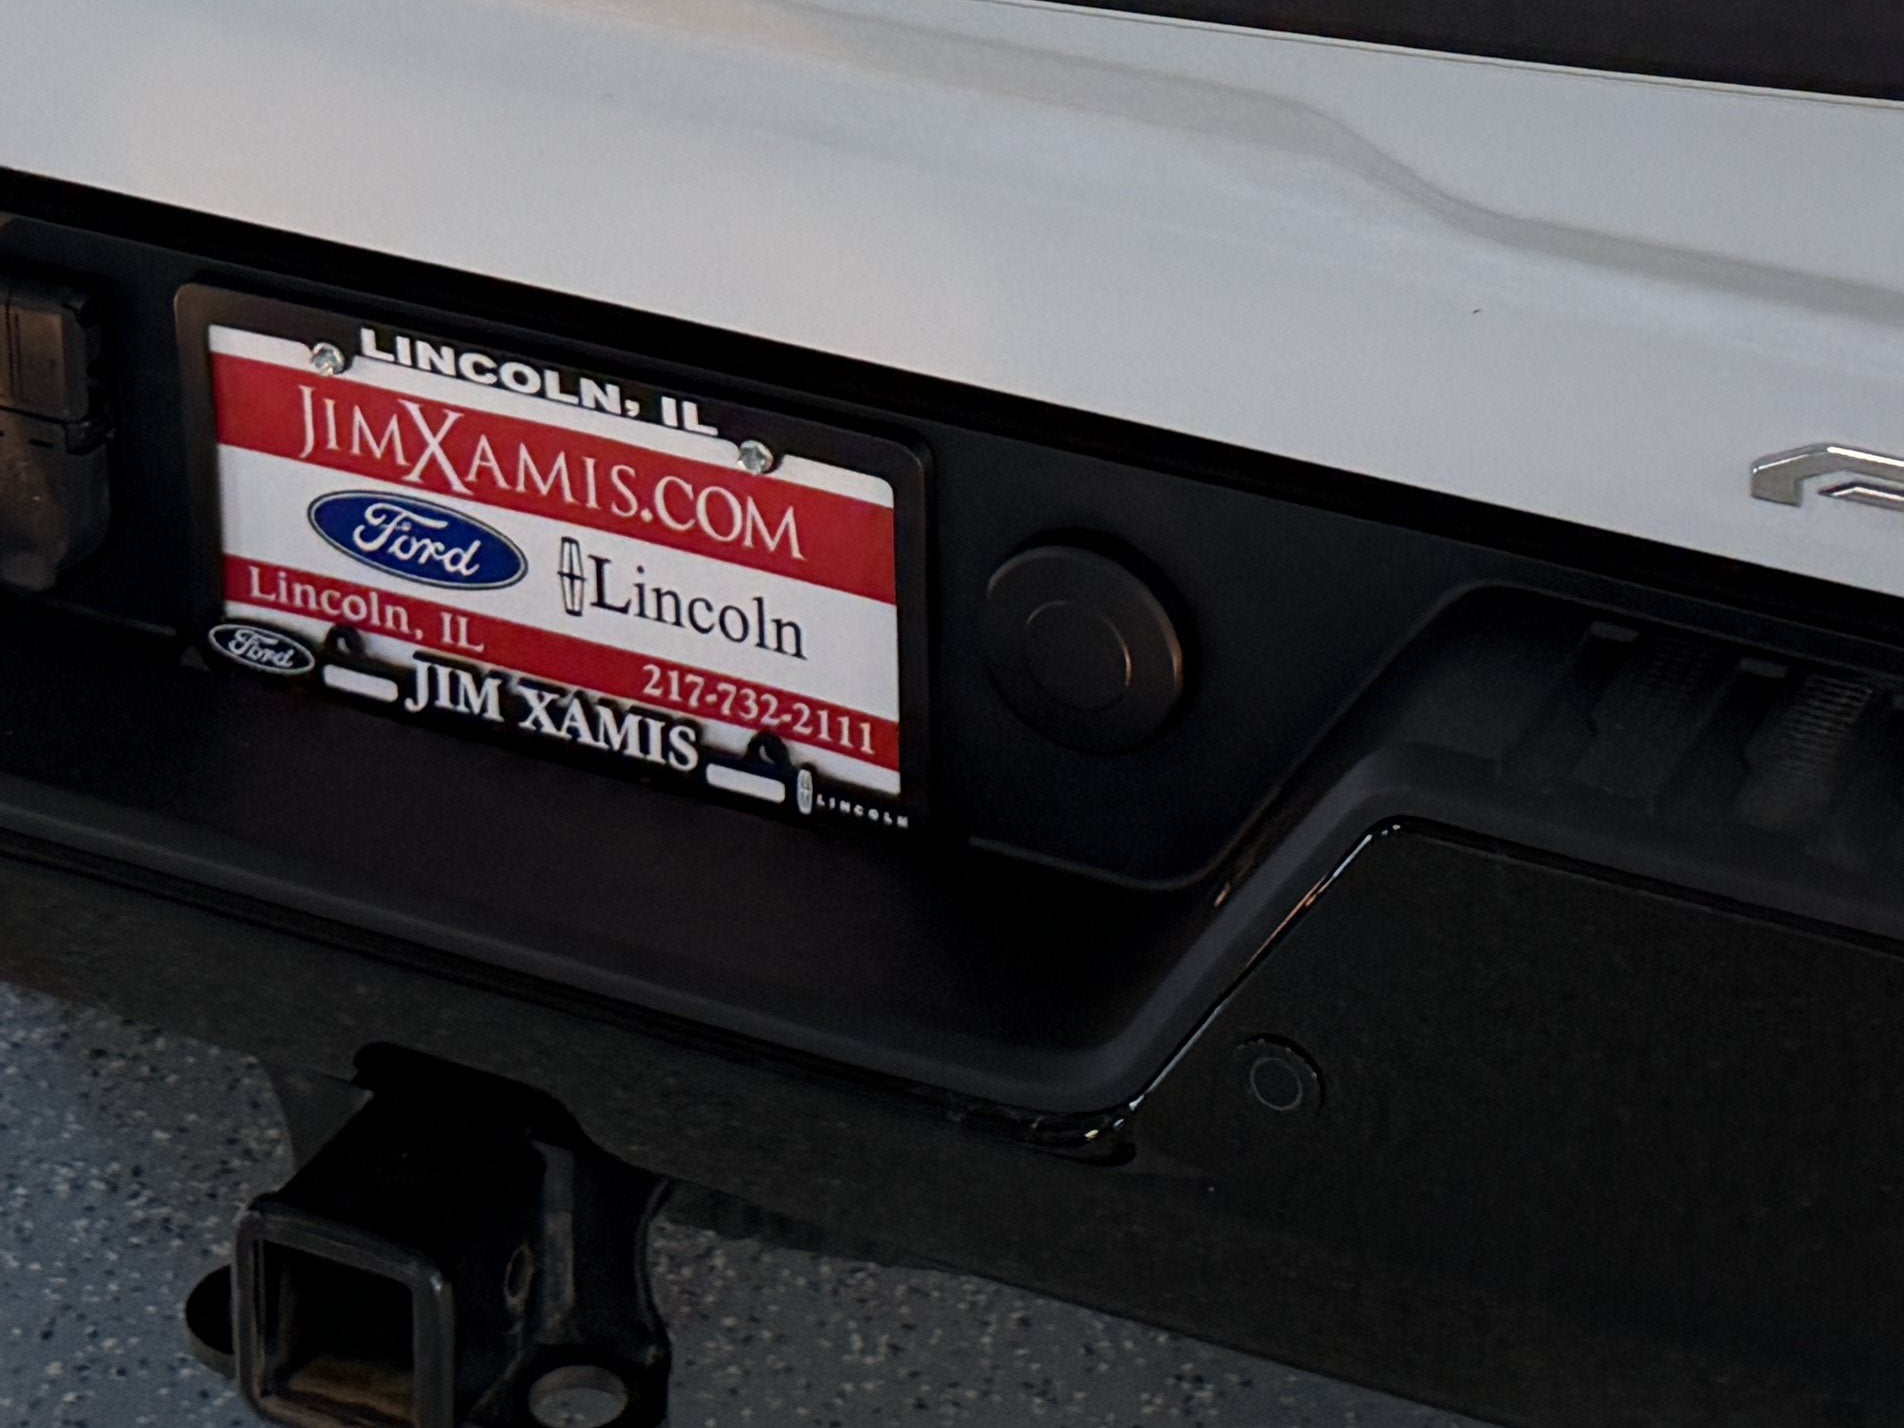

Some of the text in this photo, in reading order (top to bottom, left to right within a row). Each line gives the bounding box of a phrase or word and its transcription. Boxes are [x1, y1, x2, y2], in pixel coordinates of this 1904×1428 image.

[360, 327, 720, 438] LINCOLN, IL
[297, 384, 807, 561] JIMXAMIS.COM
[352, 501, 484, 578] Ford
[227, 626, 295, 671] Ford
[247, 566, 485, 653] Lincoln, IL
[588, 554, 808, 660] Lincoln
[405, 658, 699, 772] JIM XAMIS
[641, 663, 877, 756] 217-732-2111
[816, 793, 909, 828] LINCOLN
